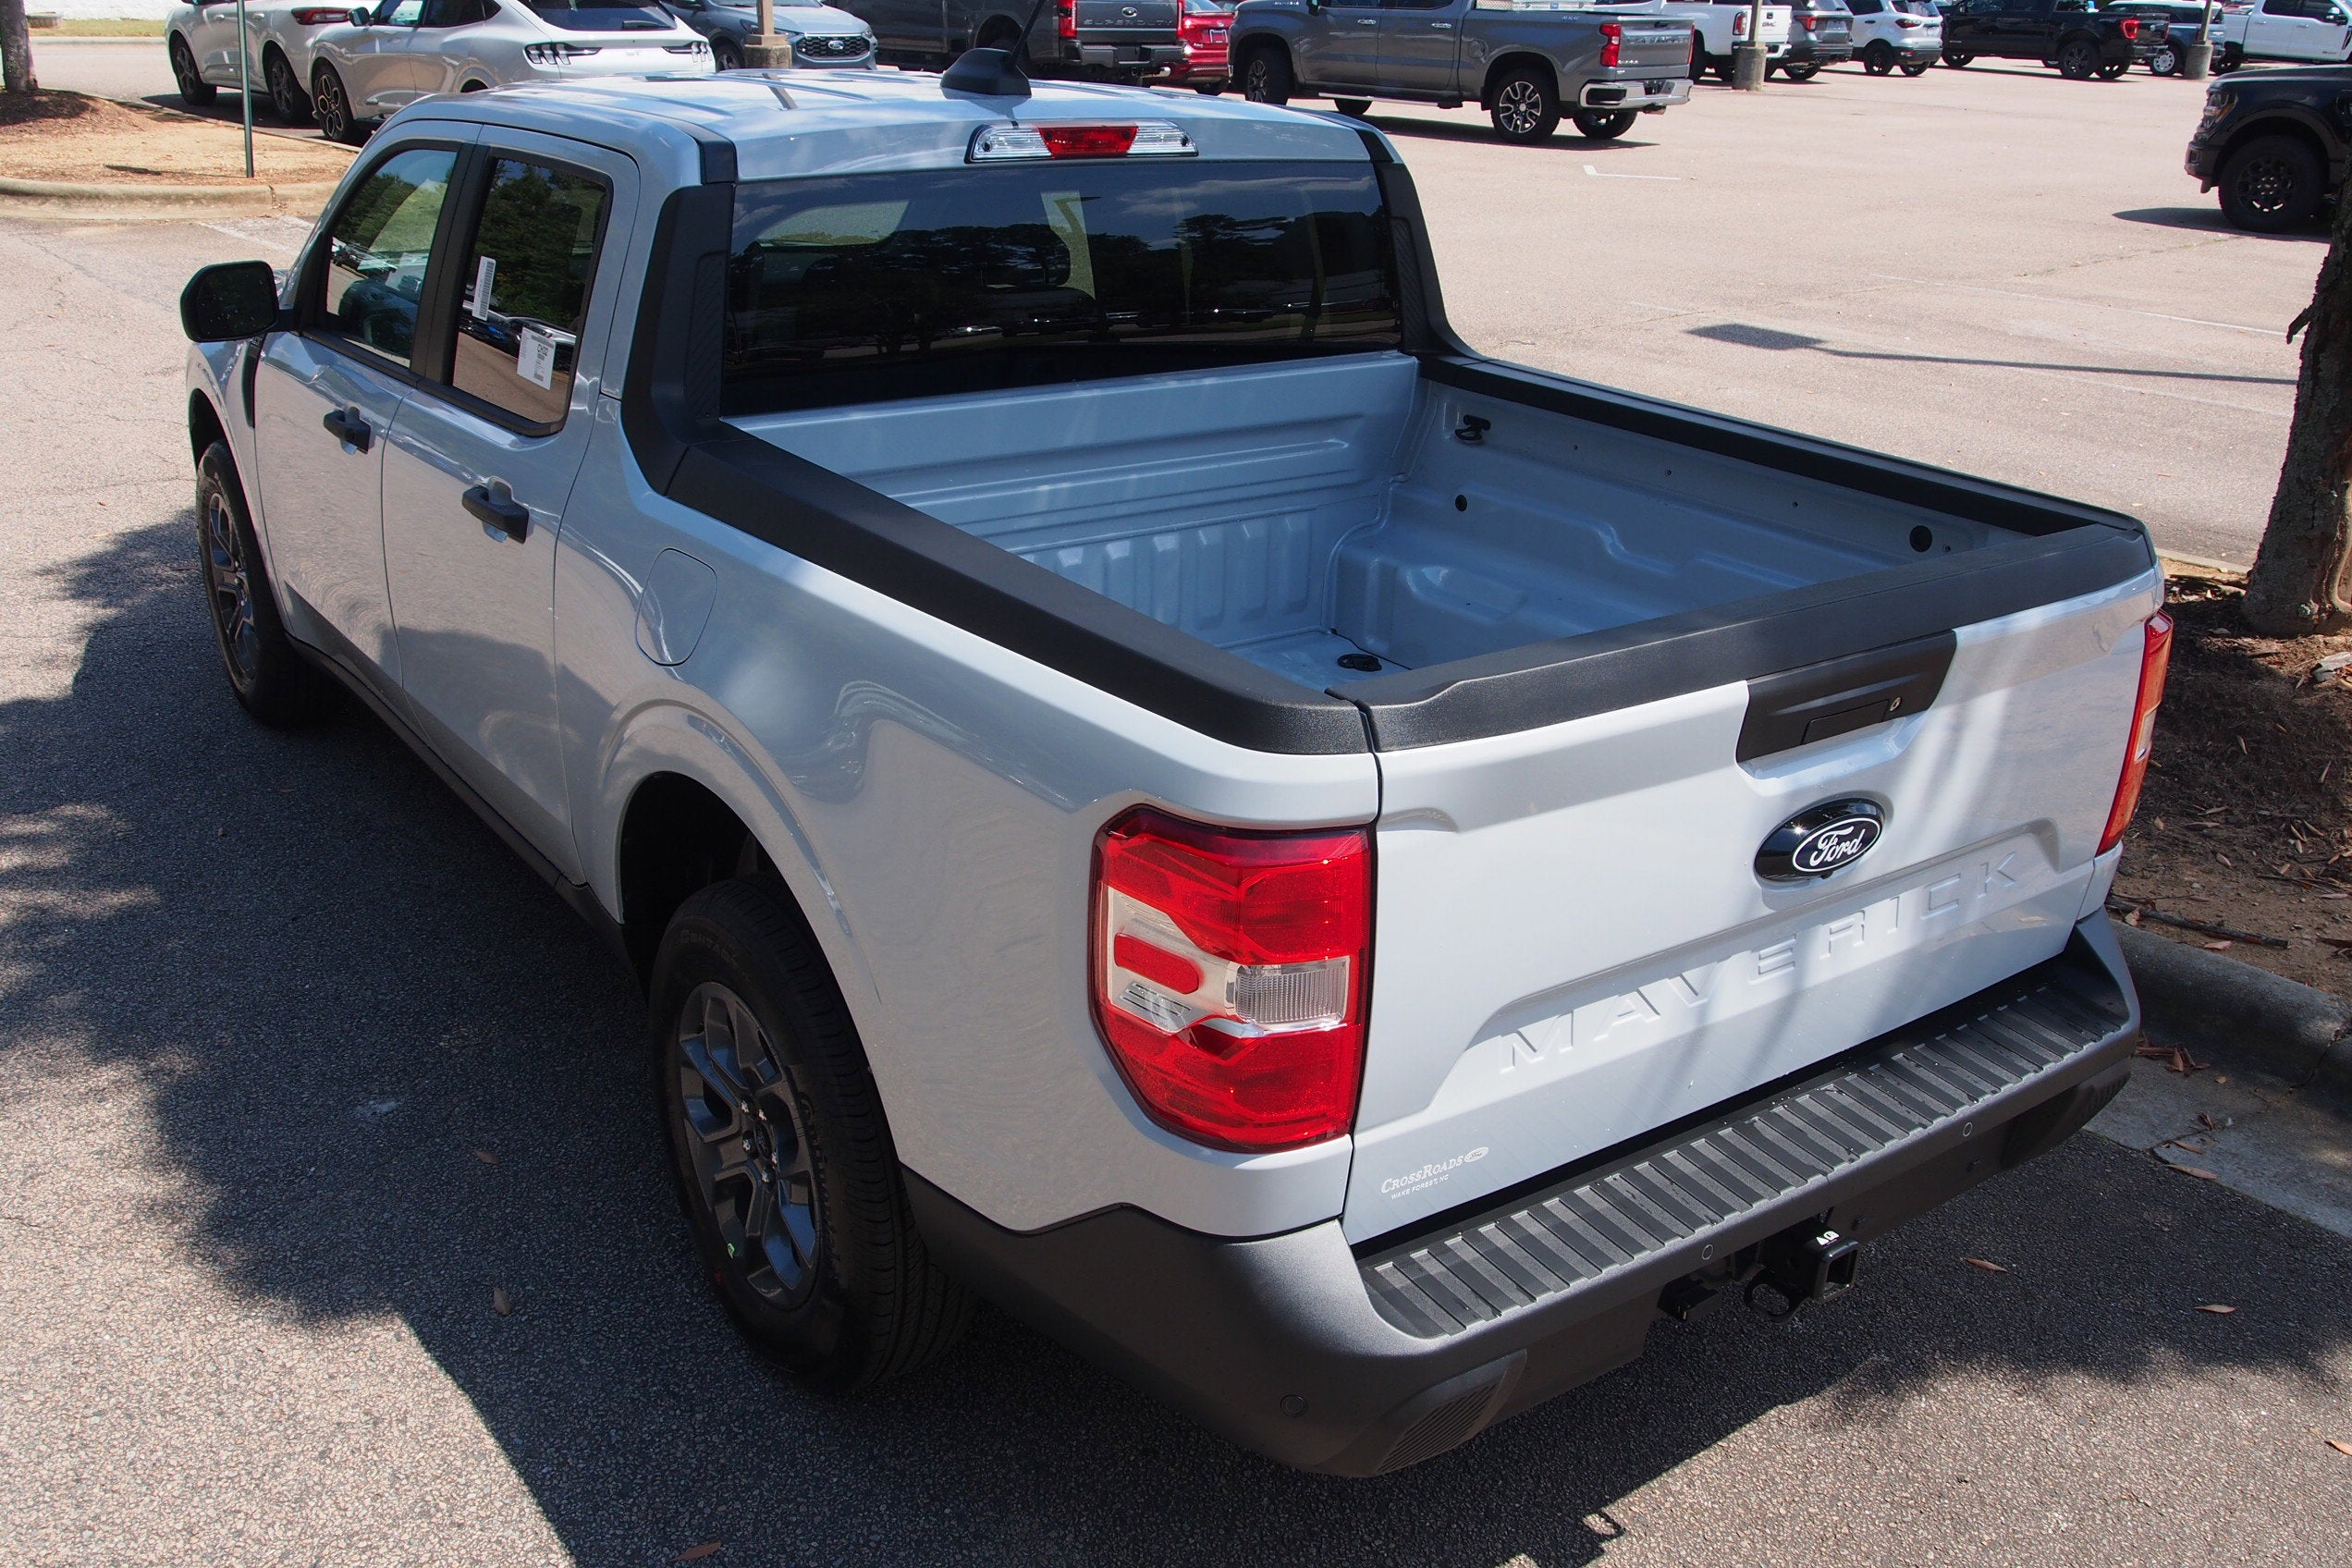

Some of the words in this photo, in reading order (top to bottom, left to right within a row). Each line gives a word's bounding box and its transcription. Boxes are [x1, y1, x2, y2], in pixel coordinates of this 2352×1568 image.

[1809, 826, 1866, 867] Ford
[1499, 851, 2017, 1074] MAVERICK
[1390, 1189, 1411, 1200] WAKE
[1439, 1173, 1449, 1184] NC
